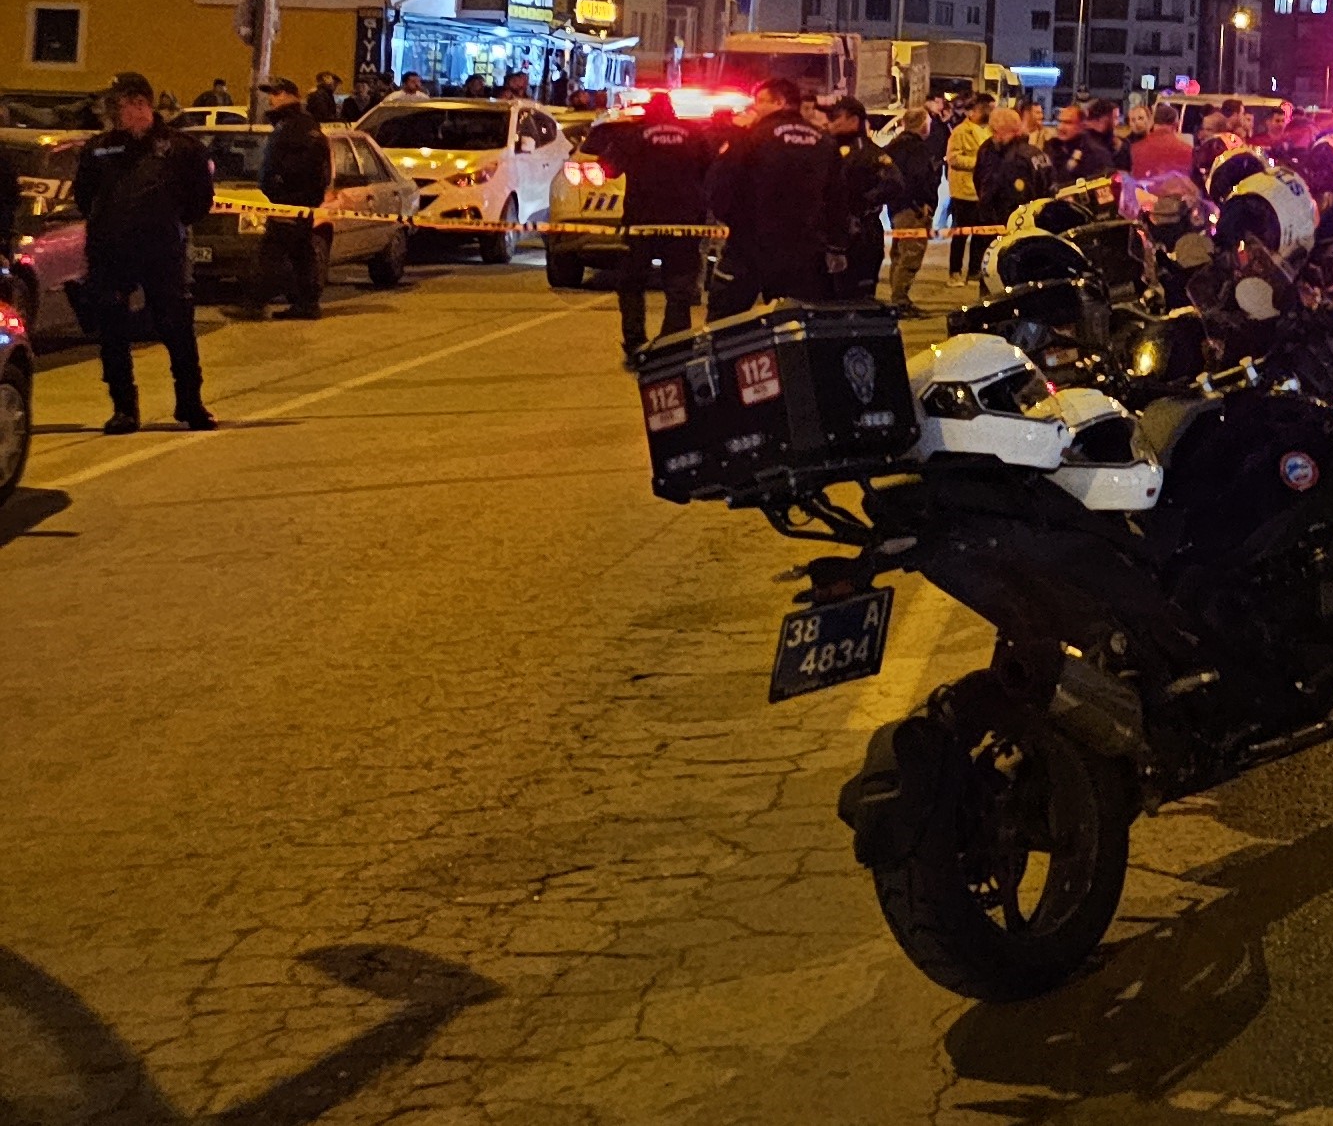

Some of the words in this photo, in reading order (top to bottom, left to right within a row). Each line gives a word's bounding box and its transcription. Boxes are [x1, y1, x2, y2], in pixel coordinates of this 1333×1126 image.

[742, 356, 773, 385] 112
[649, 384, 681, 412] 112
[786, 615, 821, 648] 38
[863, 601, 878, 631] A
[799, 635, 870, 675] 4834
